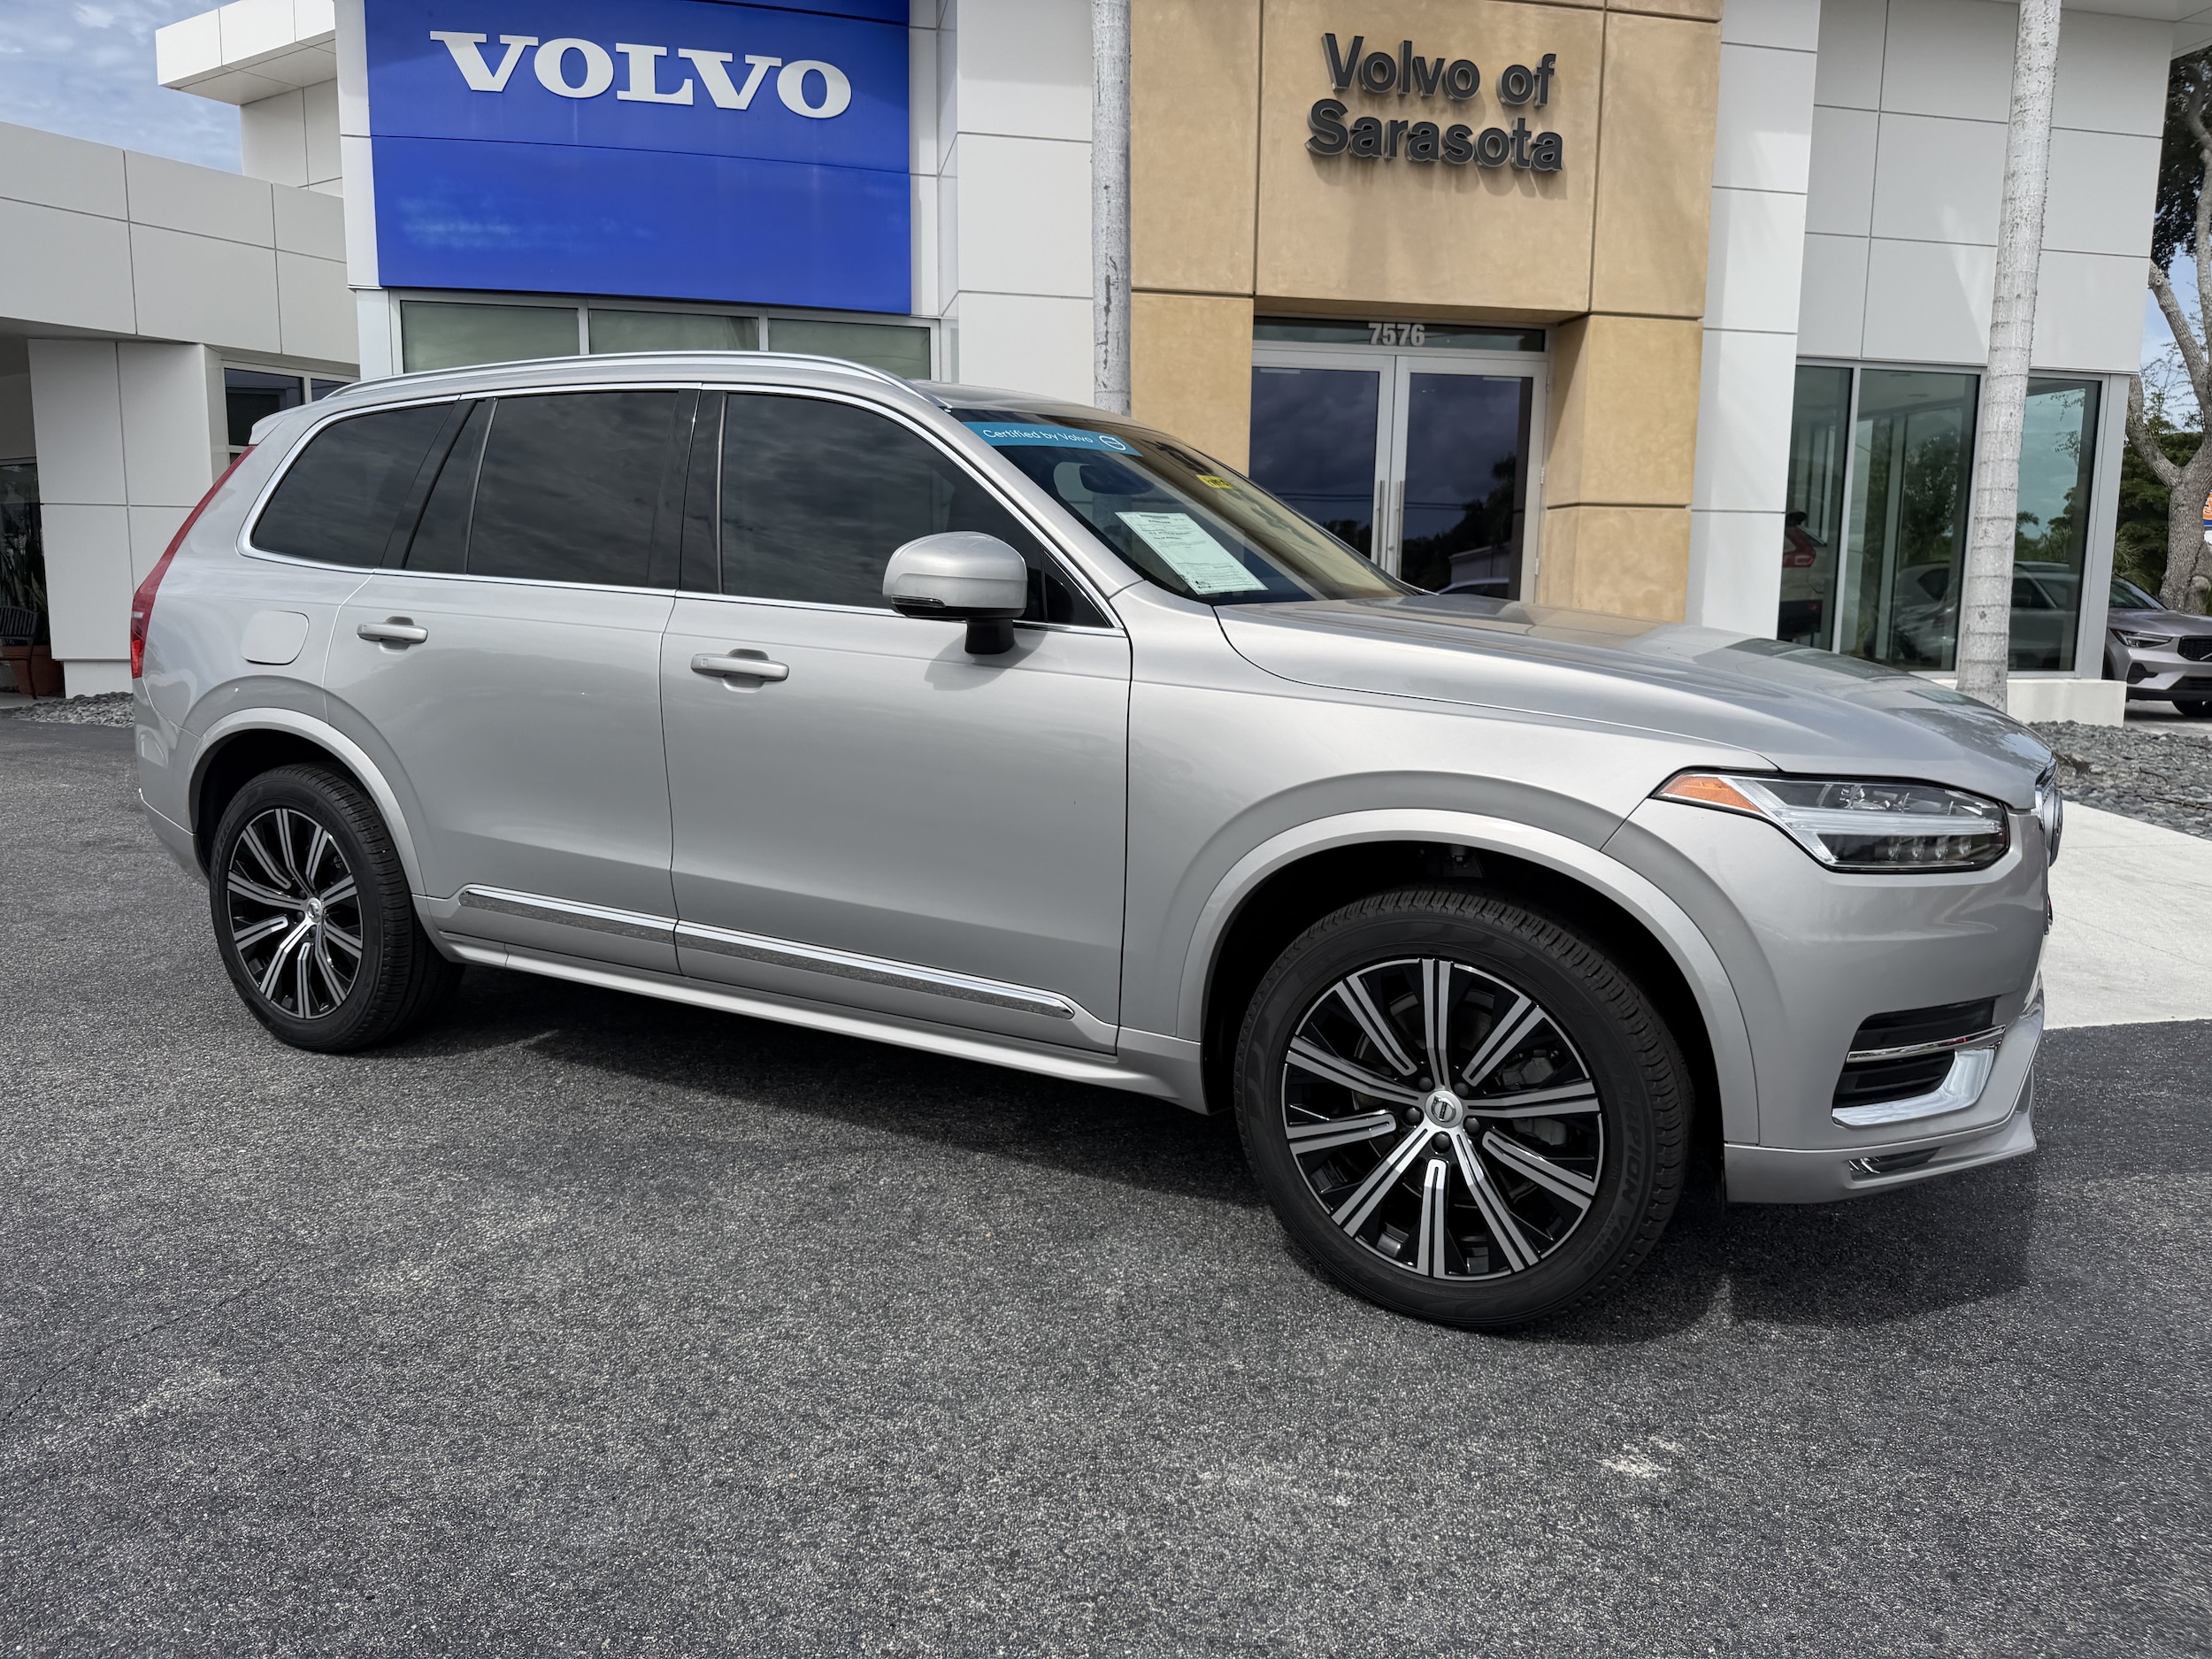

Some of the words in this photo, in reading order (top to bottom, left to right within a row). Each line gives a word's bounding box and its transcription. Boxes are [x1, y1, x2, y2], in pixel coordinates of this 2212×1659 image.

[430, 31, 852, 119] VOLVO
[1321, 33, 1480, 102] Volvo
[1496, 53, 1556, 108] of
[1304, 98, 1563, 172] Sarasota
[1368, 322, 1425, 347] 7576
[982, 429, 1041, 439] Certified
[1040, 431, 1059, 442] by
[1058, 433, 1094, 443] Volvo
